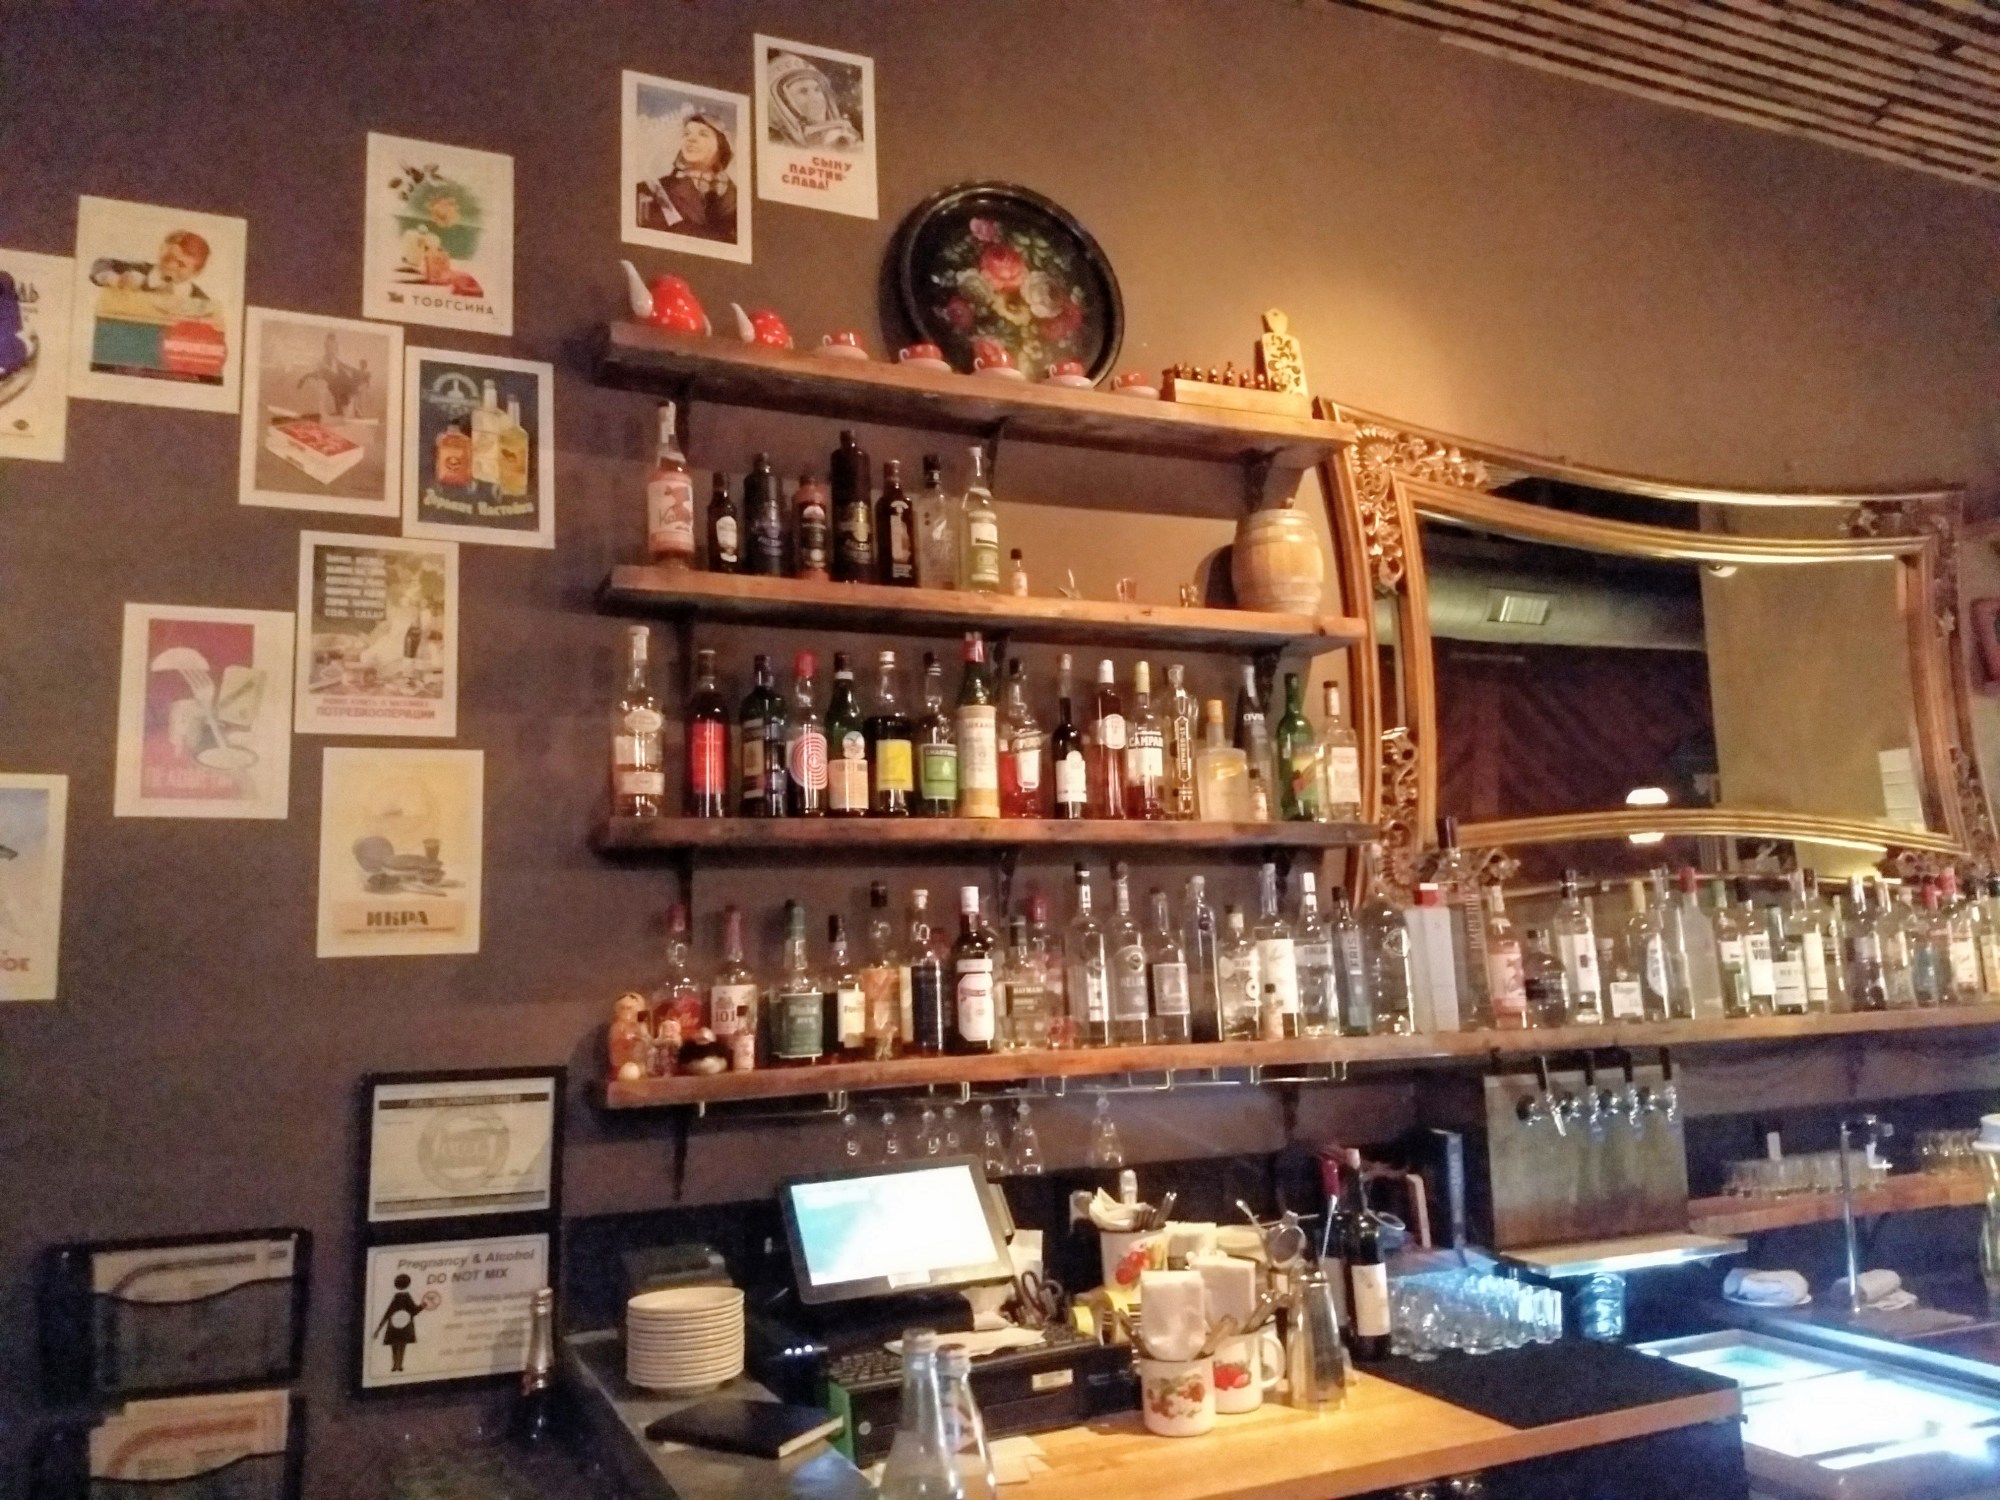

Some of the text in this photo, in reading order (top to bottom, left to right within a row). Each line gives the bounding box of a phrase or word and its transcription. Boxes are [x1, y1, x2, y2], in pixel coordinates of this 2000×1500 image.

[812, 156, 852, 173] СЫНУ
[411, 295, 495, 315] ТОРГСИНА
[714, 1010, 736, 1022] 101
[397, 1248, 535, 1271] Pregnancy & Alcohol
[426, 1267, 509, 1285] DO NOT MIX
